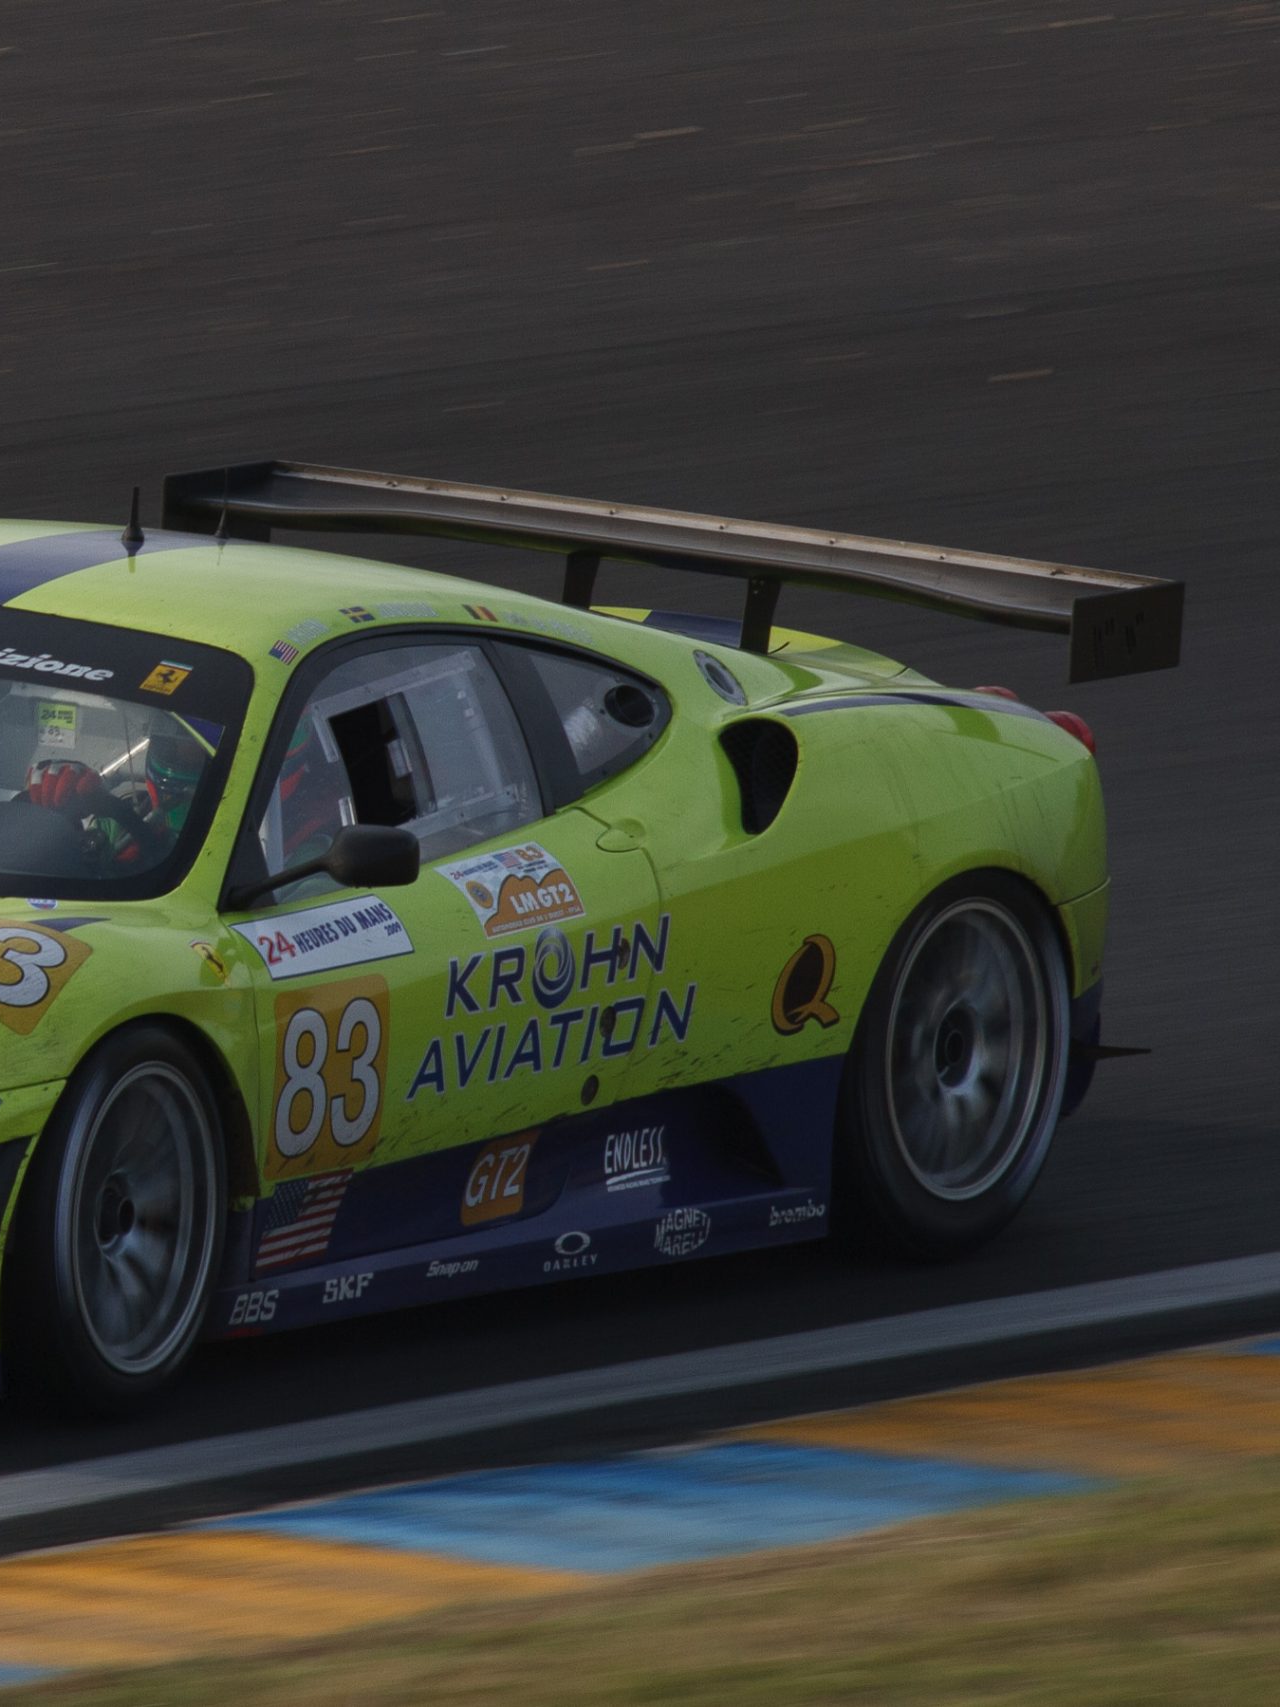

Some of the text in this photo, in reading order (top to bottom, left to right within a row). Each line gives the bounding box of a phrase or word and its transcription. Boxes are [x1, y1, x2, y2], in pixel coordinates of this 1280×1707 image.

[257, 903, 393, 965] 24 HEURES DU MANS
[384, 922, 402, 937] 2009
[445, 913, 671, 1019] KROHN
[771, 933, 840, 1035] Q
[406, 984, 696, 1100] AVIATION
[274, 996, 383, 1158] 83
[463, 1144, 532, 1209] GT2
[604, 1124, 665, 1175] ENDLESS
[769, 1199, 826, 1226] brembo
[322, 1272, 373, 1304] SKF
[543, 1254, 599, 1273] OAKLEY
[228, 1289, 279, 1326] BBS
